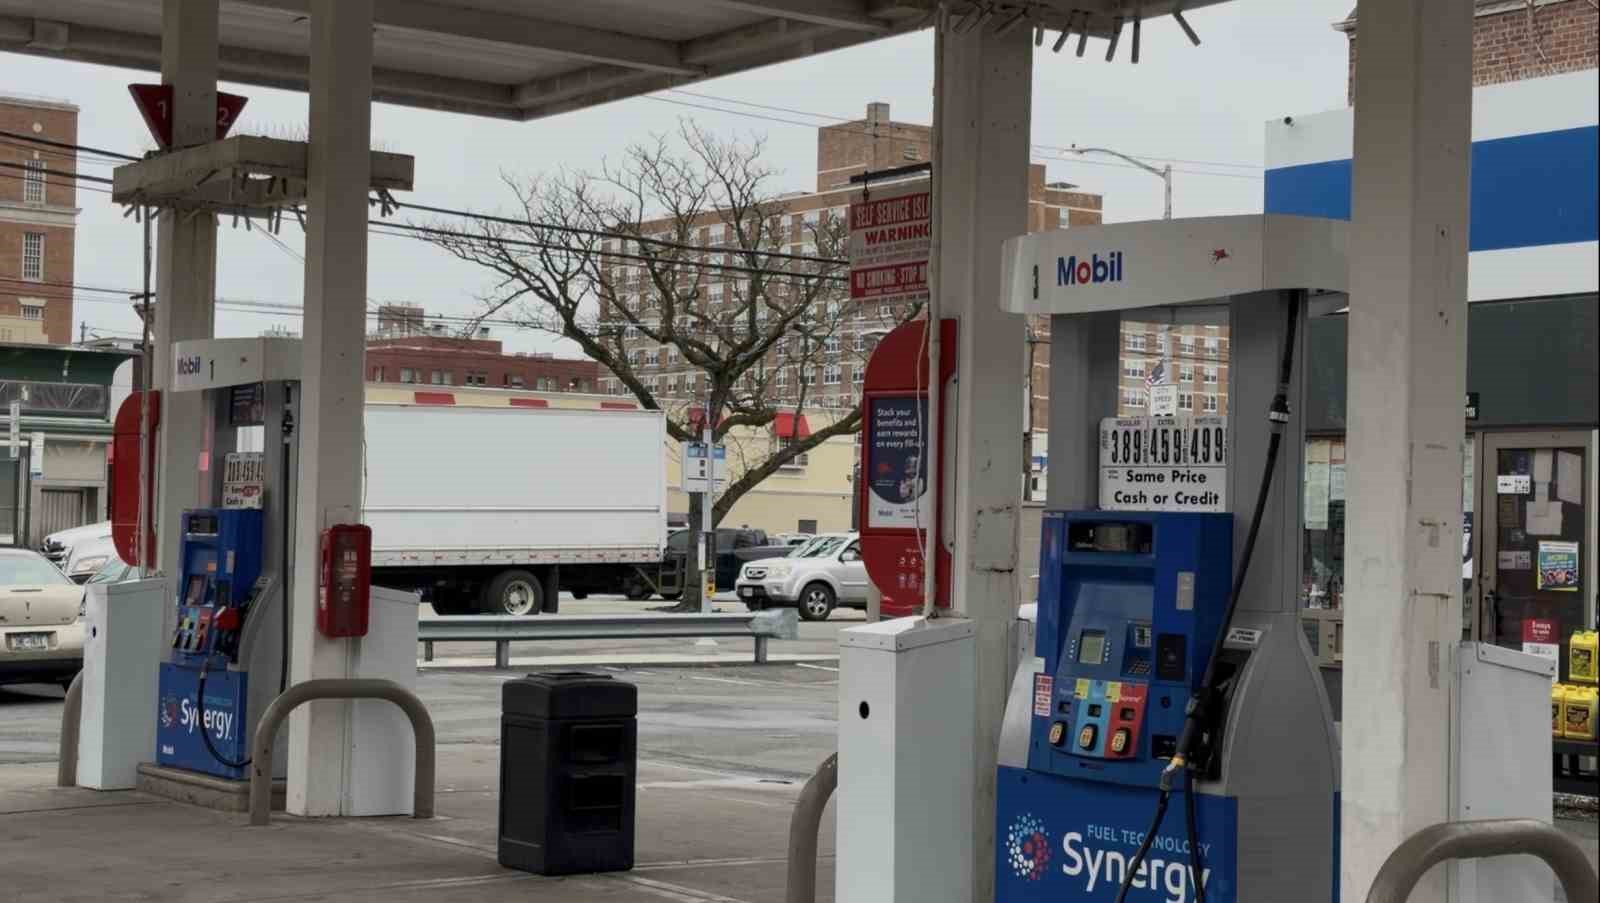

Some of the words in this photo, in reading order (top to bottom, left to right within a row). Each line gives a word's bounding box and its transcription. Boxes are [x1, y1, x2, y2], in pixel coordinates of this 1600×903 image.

[157, 101, 167, 120] 1
[218, 106, 230, 127] 2
[855, 204, 874, 227] SELF
[877, 200, 911, 225] SERVICE
[913, 195, 929, 219] ISL
[1057, 251, 1123, 287] Mobil
[1033, 264, 1040, 300] 3
[176, 356, 201, 375] Mobil
[209, 359, 215, 381] 1
[877, 408, 894, 417] Stack
[896, 409, 912, 418] your
[877, 418, 903, 427] benefits
[904, 418, 917, 427] and
[892, 430, 918, 438] rewards
[886, 441, 904, 449] every
[1111, 429, 1141, 464] 3.89
[1150, 427, 1182, 464] 4.59
[1190, 426, 1224, 464] 4.99
[1126, 469, 1165, 482] Same
[1171, 469, 1207, 483] Price
[1114, 490, 1148, 504] Cash
[1153, 494, 1169, 505] or
[1174, 490, 1219, 506] Credit
[1087, 824, 1118, 842] FUEL
[1121, 829, 1211, 857] TECNOLOY
[1062, 832, 1211, 903] Synergy
